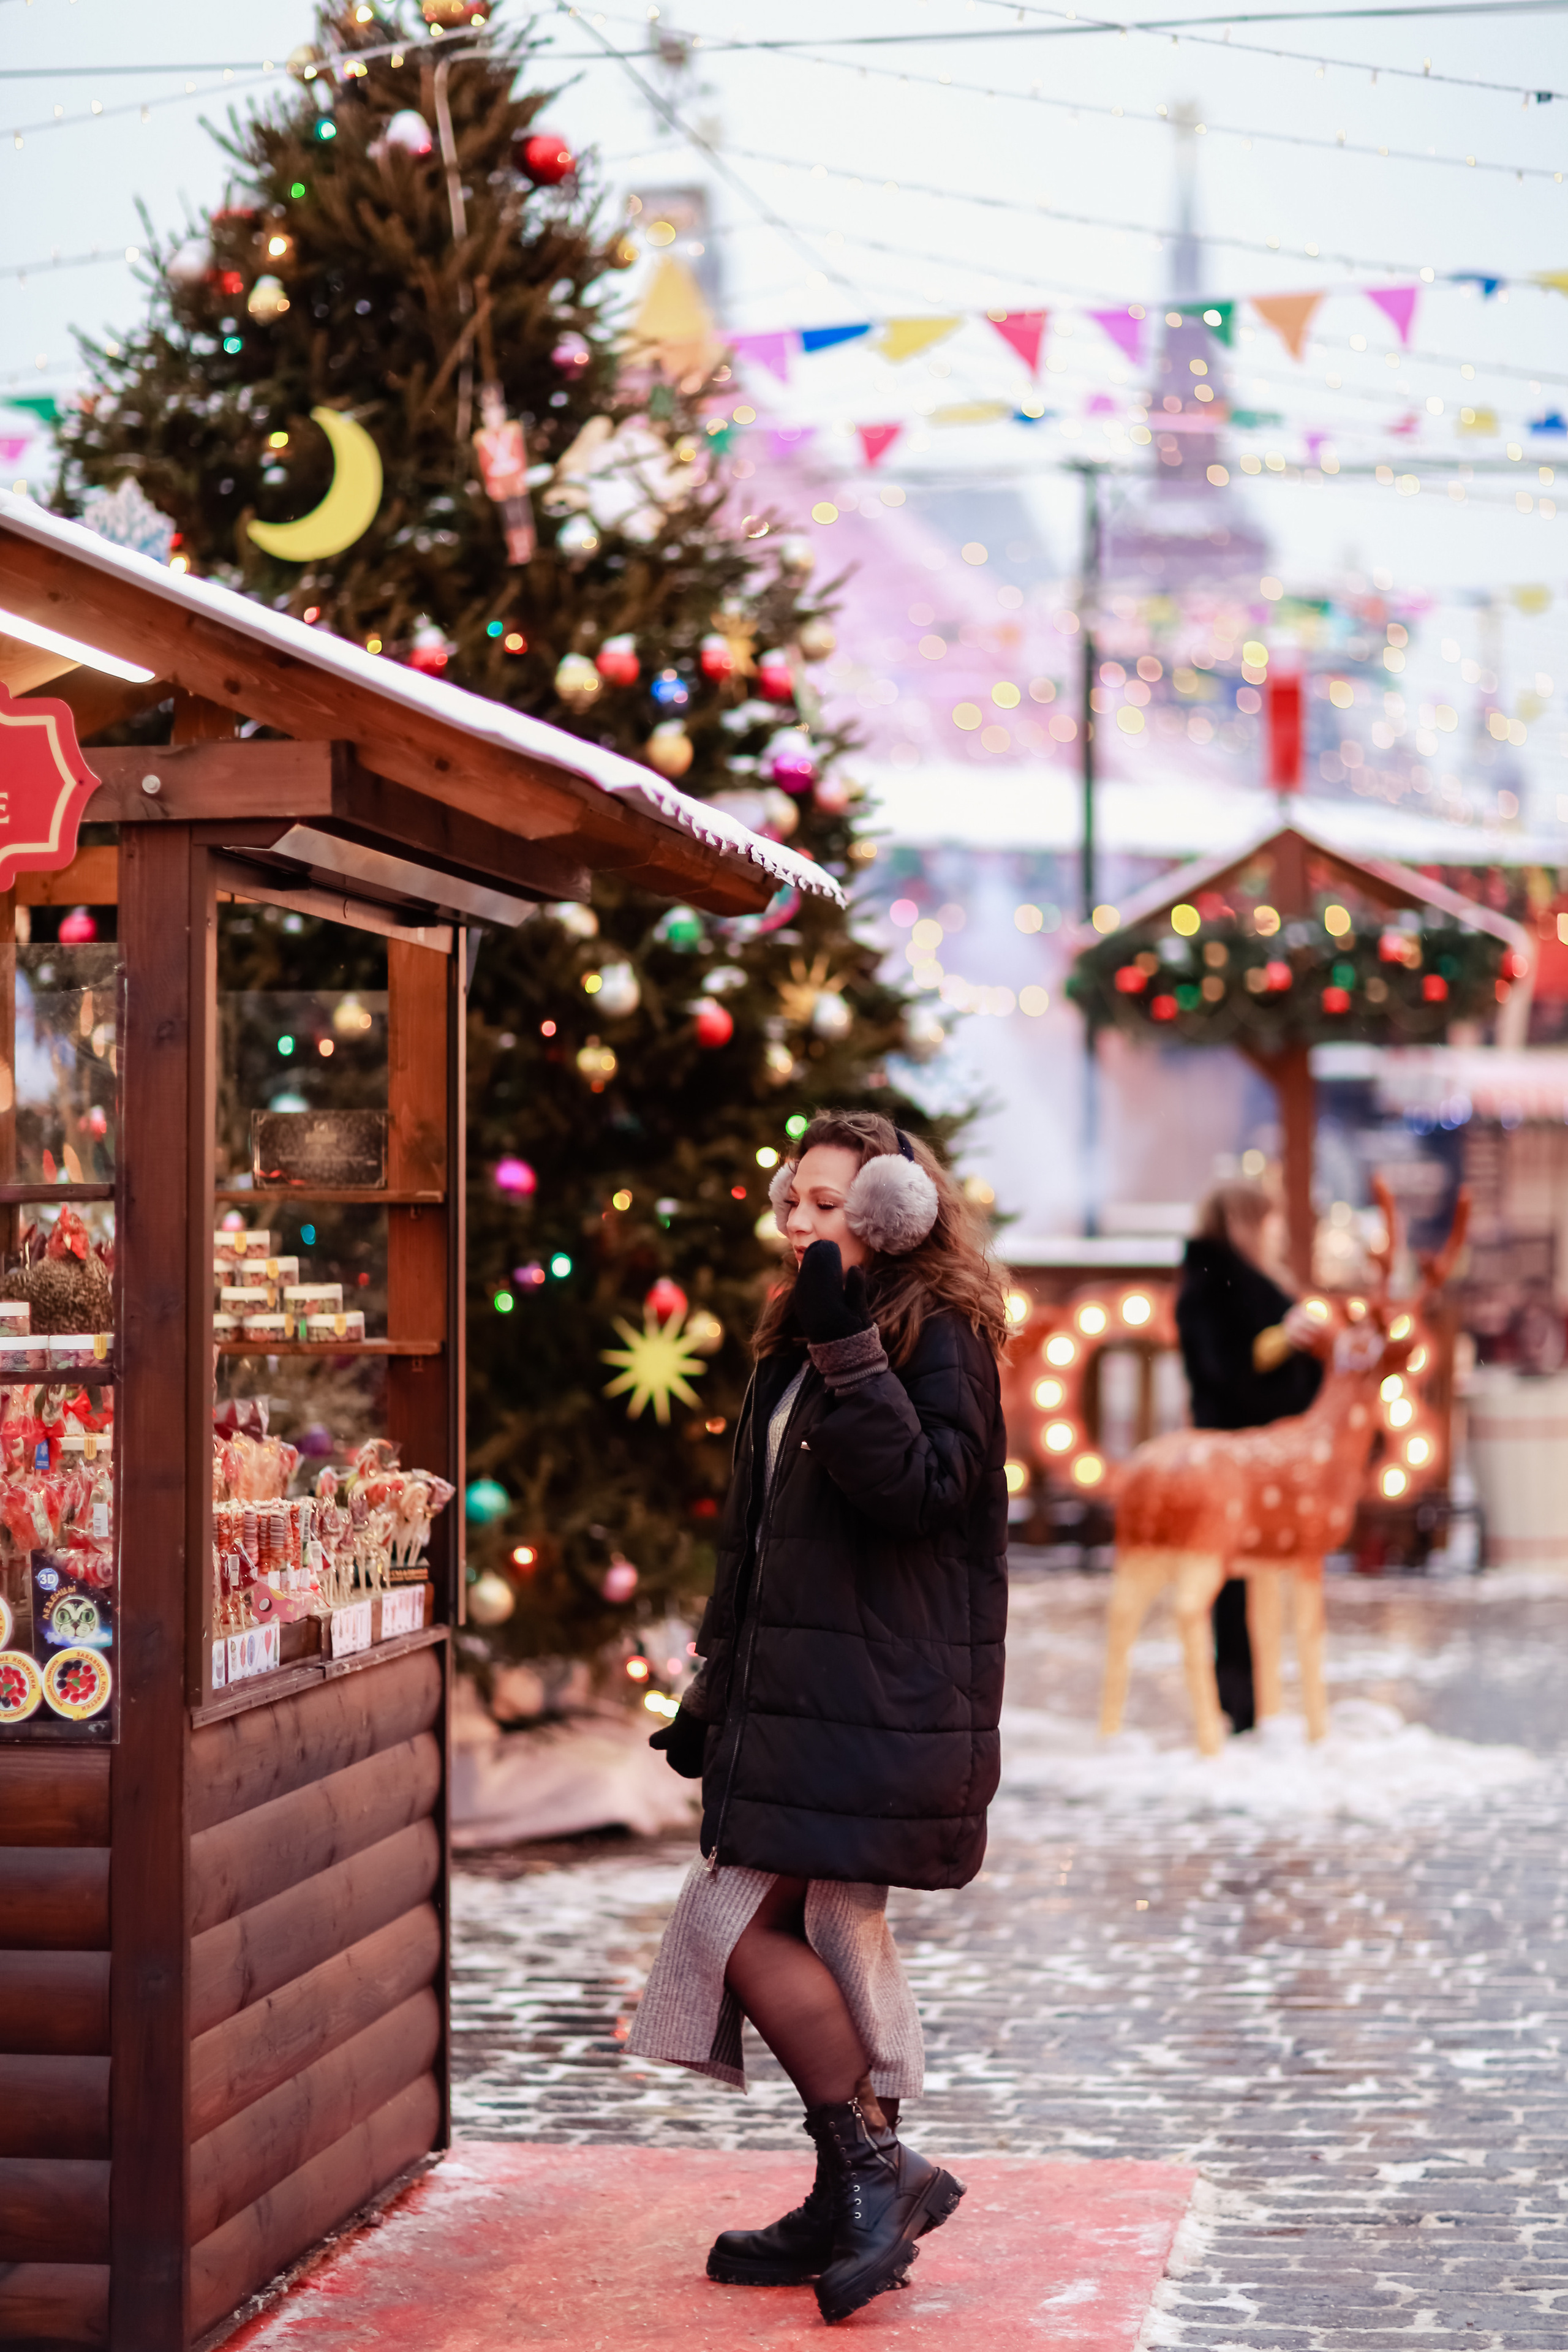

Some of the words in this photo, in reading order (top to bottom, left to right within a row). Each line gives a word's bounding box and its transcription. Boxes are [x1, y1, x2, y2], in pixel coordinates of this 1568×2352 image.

[40, 1574, 56, 1585] 3D
[42, 1585, 77, 1619] ЛЕДЕНЦЫ
[13, 1657, 36, 1689] КОНФЕТКИ
[77, 1652, 105, 1677] ЗАБАВНЫЕ
[81, 1681, 106, 1711] КОНФЕТКИ
